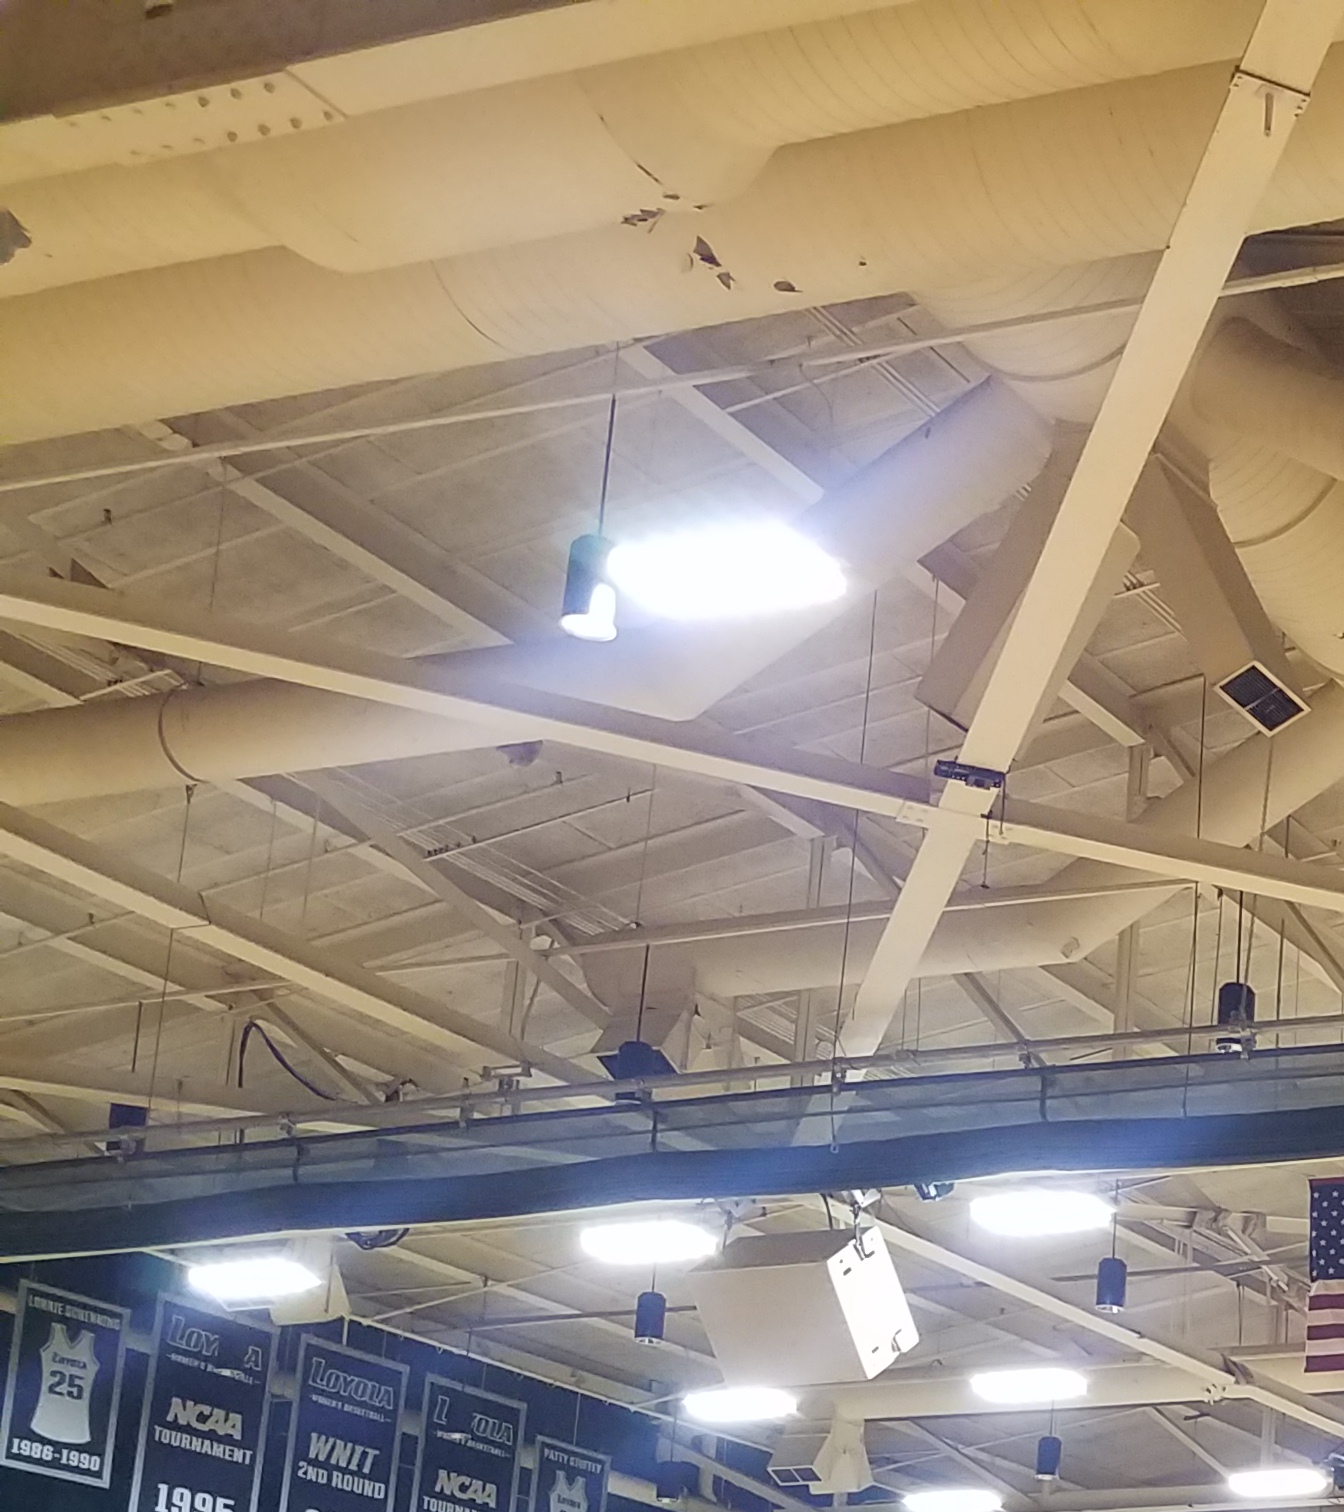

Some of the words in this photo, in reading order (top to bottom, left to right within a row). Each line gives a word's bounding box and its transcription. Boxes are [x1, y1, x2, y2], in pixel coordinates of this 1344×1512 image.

[167, 1315, 262, 1371] LOYA
[48, 1370, 85, 1400] 25
[308, 1357, 394, 1410] LOYOLA
[166, 1397, 242, 1440] NCAA
[434, 1395, 513, 1446] LOLA
[11, 1438, 101, 1471] 1986-1990
[153, 1426, 253, 1465] TOURNAMENT
[308, 1432, 380, 1474] WNIT
[297, 1461, 328, 1485] 2ND
[331, 1470, 386, 1500] ROUND
[434, 1469, 497, 1509] NCAA
